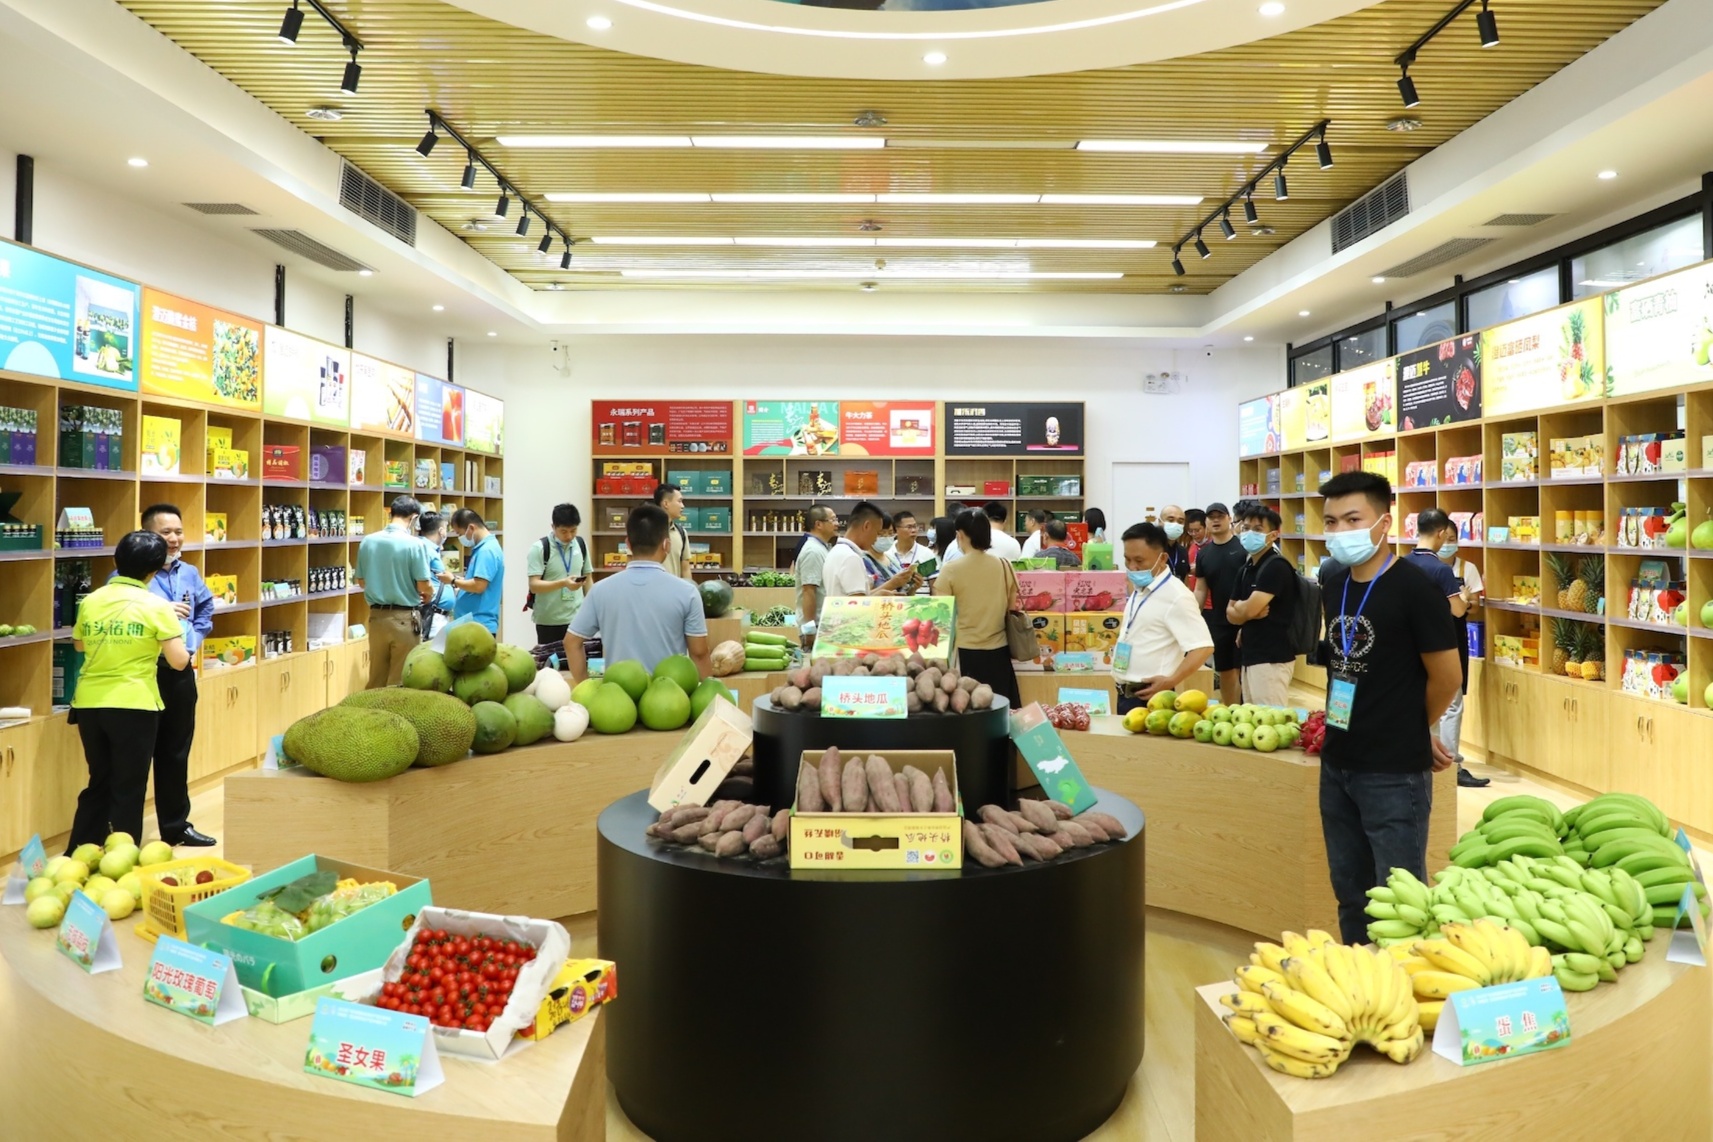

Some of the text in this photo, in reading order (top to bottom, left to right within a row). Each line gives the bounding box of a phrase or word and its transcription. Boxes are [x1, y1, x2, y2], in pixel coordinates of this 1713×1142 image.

[875, 601, 895, 639] 桥头地瓜
[839, 692, 888, 704] 桥头地瓜
[905, 832, 951, 844] 桥头地瓜
[804, 851, 844, 861] 香甜可口
[152, 962, 218, 1002] 阳光玫瑰葡萄
[337, 1042, 387, 1072] 圣女果
